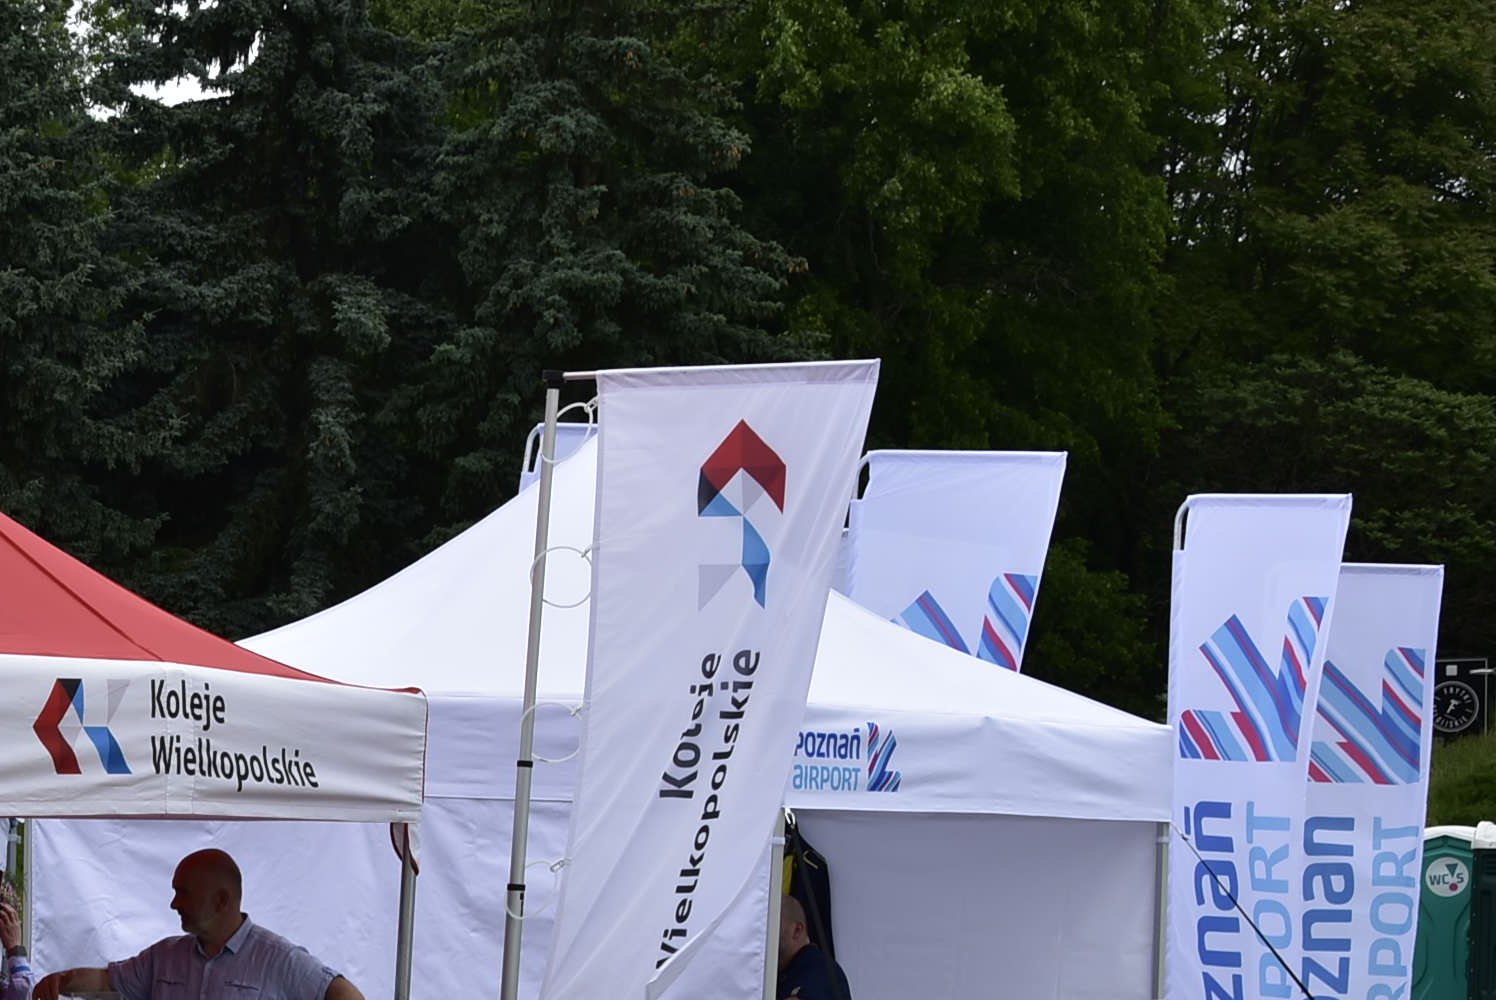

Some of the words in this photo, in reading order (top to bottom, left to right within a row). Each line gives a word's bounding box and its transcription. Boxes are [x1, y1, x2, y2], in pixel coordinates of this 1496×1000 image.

[150, 678, 226, 730] Koleje
[659, 652, 722, 799] Koleje
[150, 734, 320, 792] Wielkopolskie
